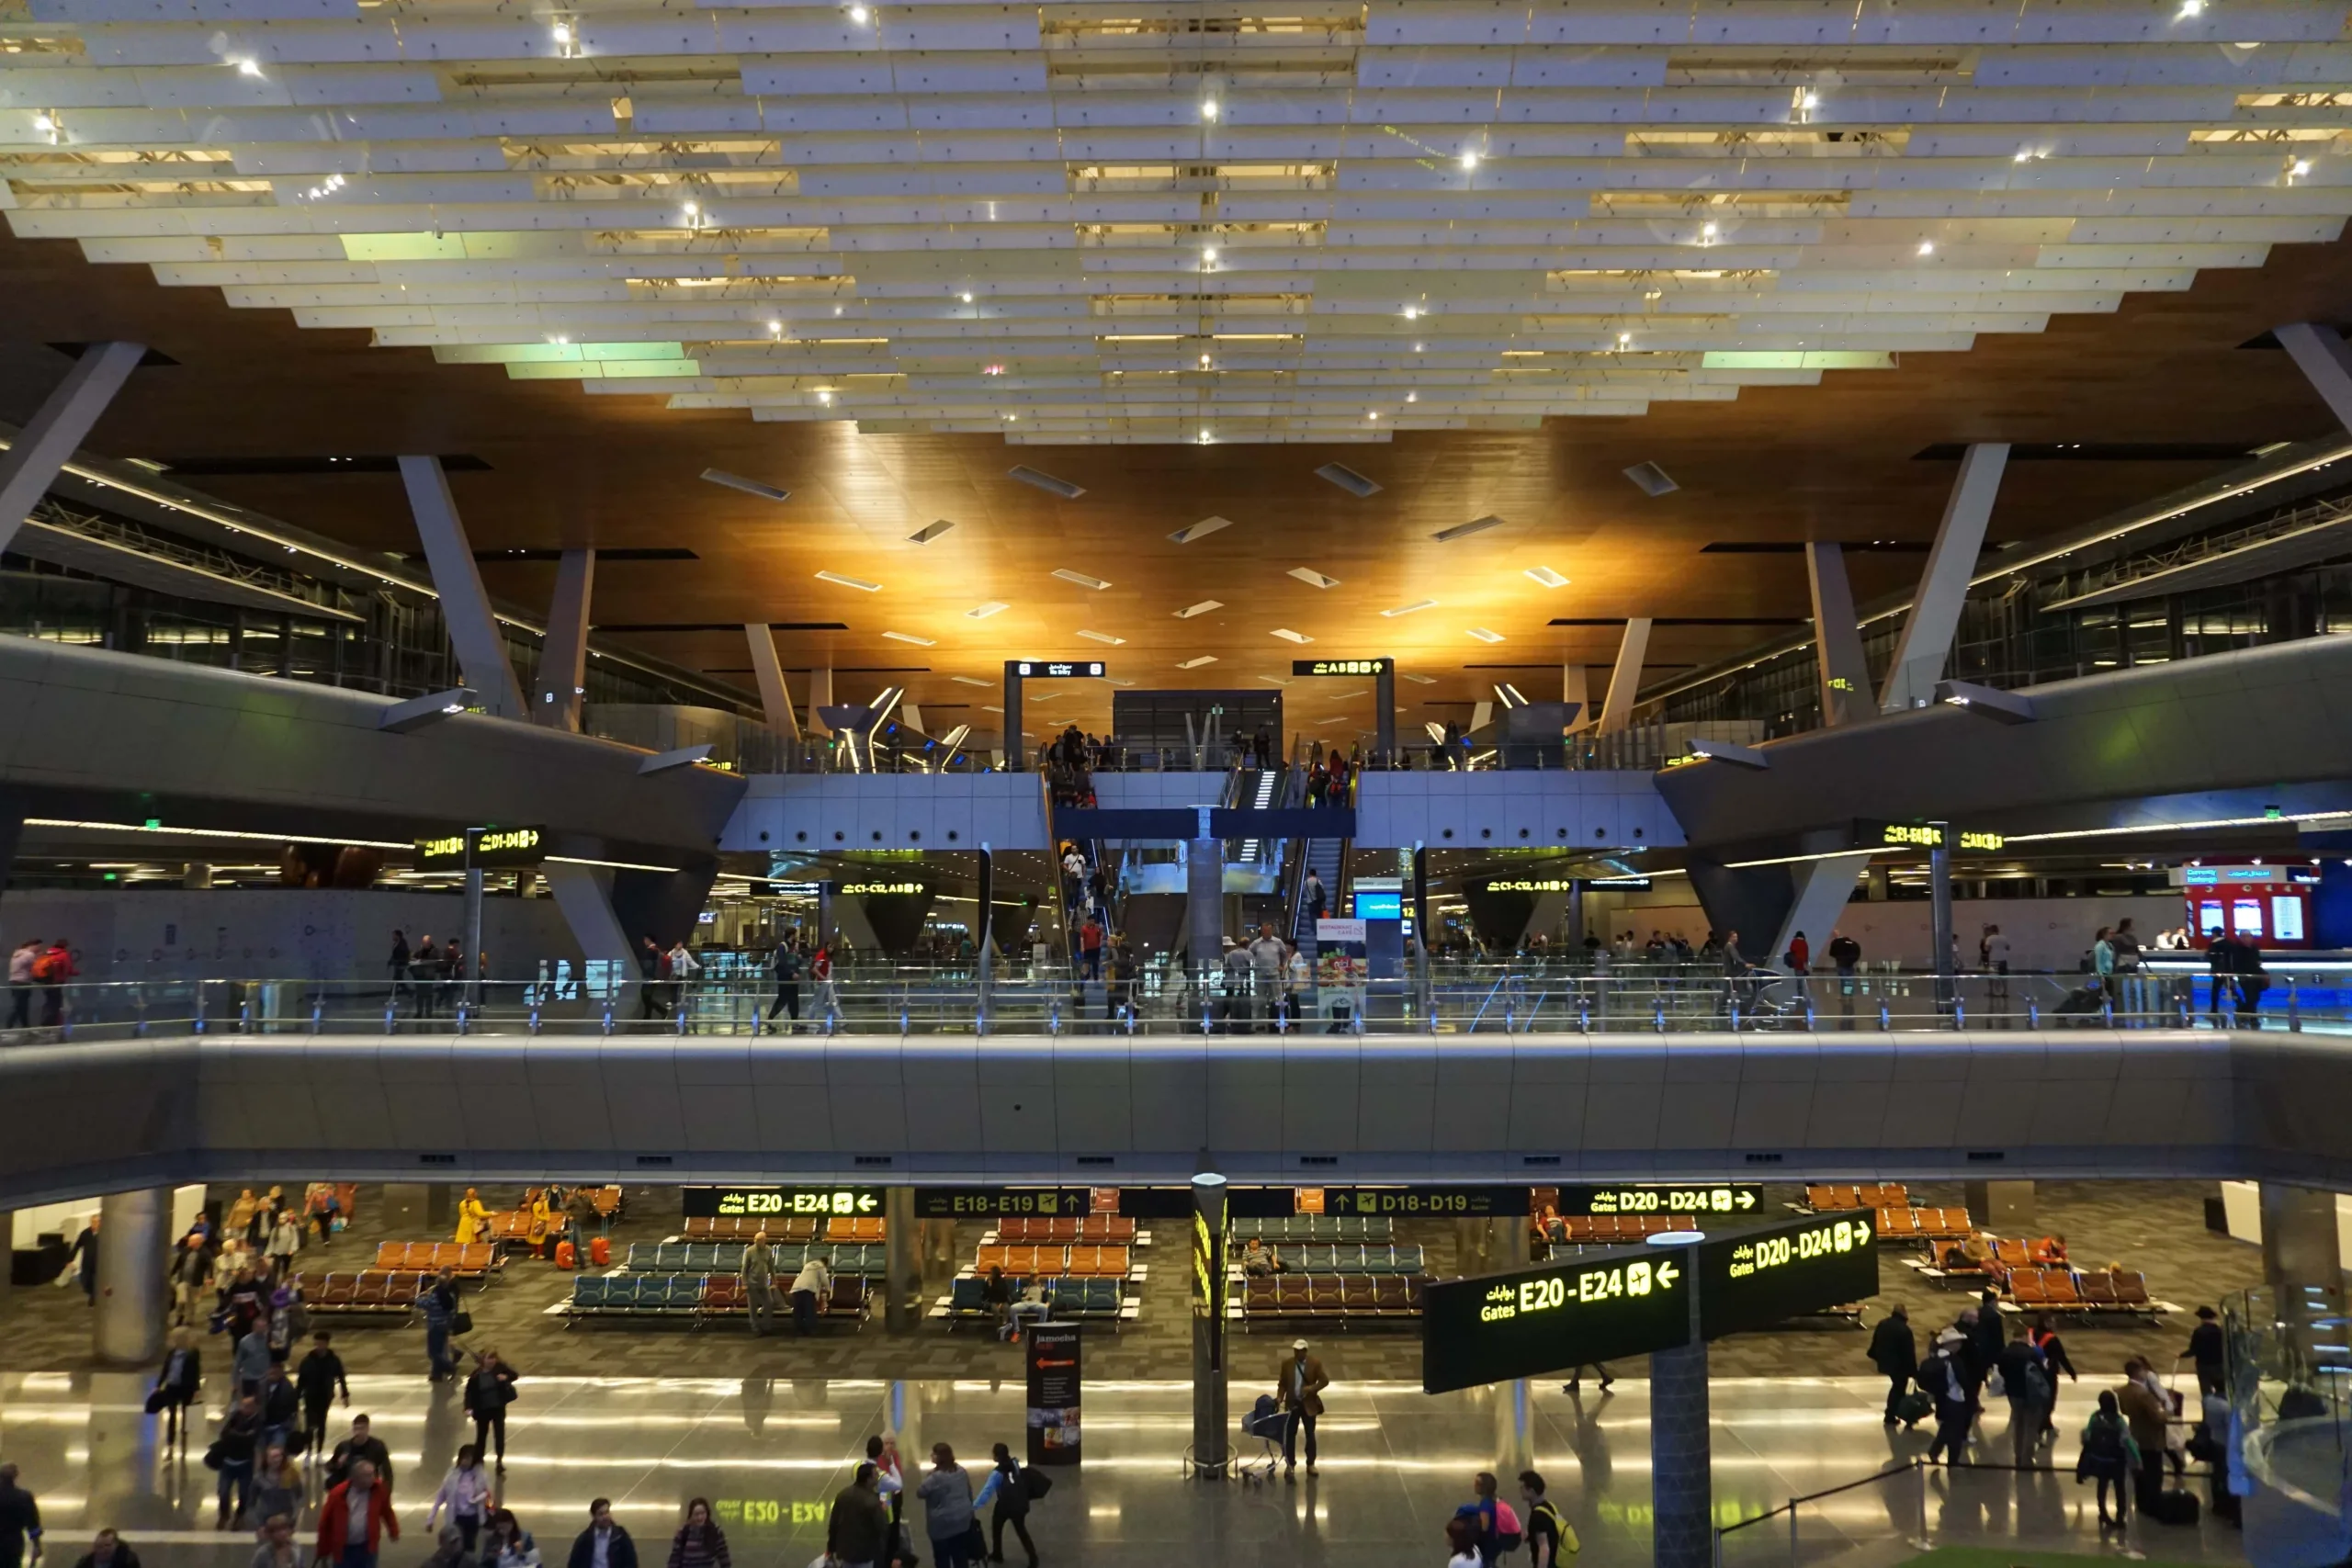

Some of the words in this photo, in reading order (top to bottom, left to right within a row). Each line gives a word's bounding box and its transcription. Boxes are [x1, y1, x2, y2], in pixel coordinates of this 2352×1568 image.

[718, 1203, 745, 1213] Gates
[954, 1196, 1034, 1212] E18-E19
[1382, 1195, 1467, 1211] D18-D19
[1590, 1202, 1617, 1213] Gates
[1730, 1262, 1755, 1278] Gates
[1487, 1284, 1515, 1301] بوابات
[1481, 1304, 1516, 1322] Gates
